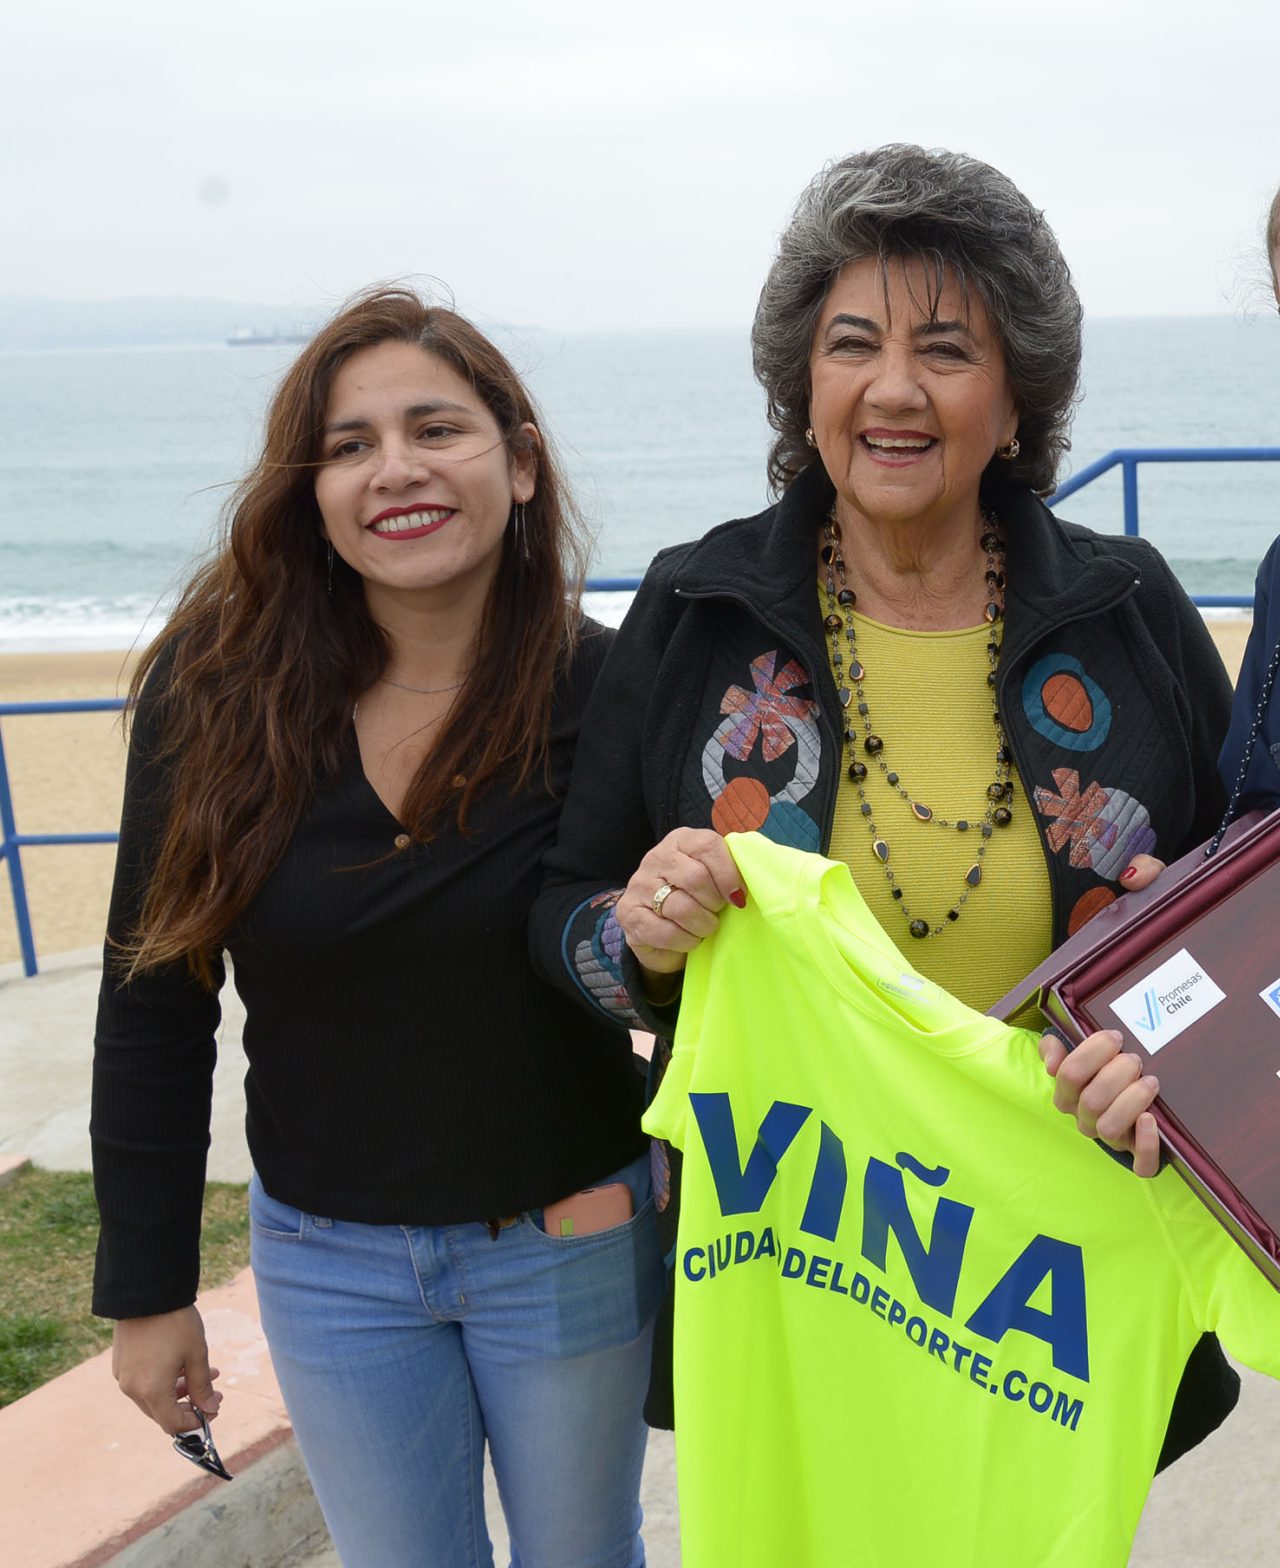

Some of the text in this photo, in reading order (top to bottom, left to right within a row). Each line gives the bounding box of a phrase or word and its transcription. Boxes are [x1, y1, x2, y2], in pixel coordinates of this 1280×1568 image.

[1158, 971, 1203, 1006] Promesas
[1166, 994, 1192, 1015] Chile
[688, 1092, 1090, 1383] VIÑA
[683, 1226, 1084, 1432] CIUDADELDEPORTE.COM
